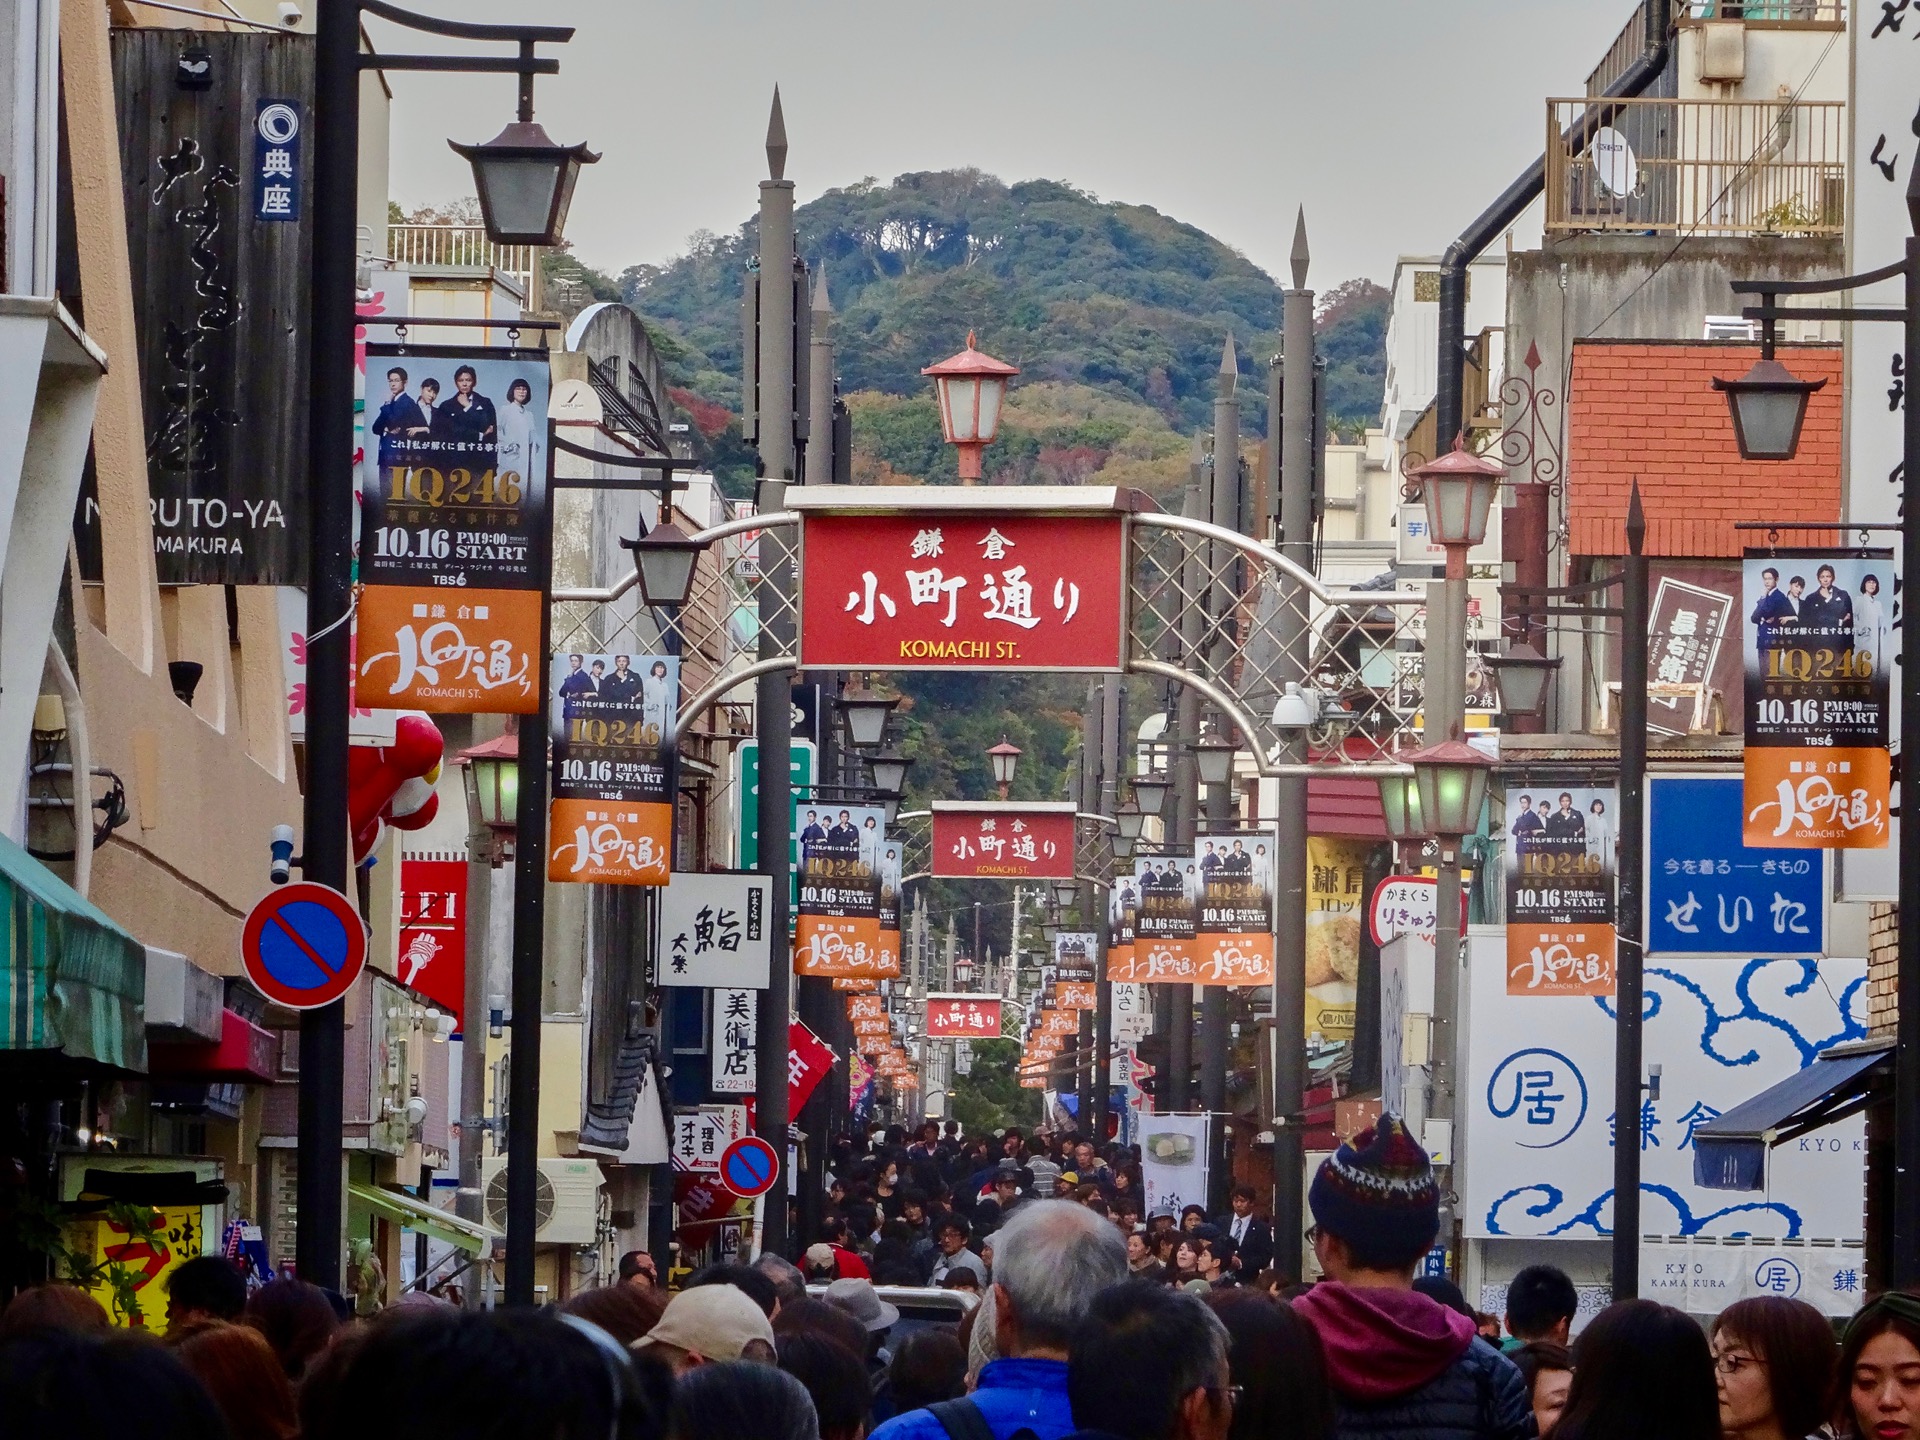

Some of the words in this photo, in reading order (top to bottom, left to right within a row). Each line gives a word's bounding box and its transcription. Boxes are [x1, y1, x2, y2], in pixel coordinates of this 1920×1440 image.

[262, 148, 293, 214] 典座
[386, 466, 521, 508] IQ246
[85, 497, 286, 529] NRUTO-YA
[153, 536, 244, 555] MAKURA
[373, 527, 450, 559] 10.16
[455, 545, 527, 561] START
[910, 527, 1016, 560] 鎌倉
[844, 564, 1080, 629] 小町通り
[430, 604, 471, 620] 鎌倉
[361, 621, 532, 696] 小町通り
[900, 640, 991, 659] KOMACHI
[996, 641, 1021, 660] ST.
[1765, 648, 1873, 682] IQ246
[416, 687, 465, 699] KOMACHI
[467, 688, 482, 699] ST.
[1755, 699, 1818, 725] 10.16
[1823, 712, 1879, 725] START
[570, 718, 661, 748] IQ246
[560, 759, 612, 782] 10.16
[1805, 761, 1837, 774] 鎌倉
[615, 772, 664, 784] START
[1749, 775, 1885, 837] 小町通り
[980, 818, 1027, 833] 鎌倉
[1795, 829, 1835, 839] KOMACHI
[1836, 830, 1846, 839] ST.
[553, 823, 666, 876] 小町通り
[952, 834, 1056, 862] 小町通り
[588, 866, 621, 876] KOMACHI
[976, 865, 1017, 874] KOMACHI
[1018, 866, 1030, 874] ST.
[1523, 851, 1601, 876] IQ246
[800, 886, 837, 903] 10.16
[838, 896, 874, 905] START
[1387, 888, 1429, 902] かまくら
[1515, 888, 1560, 908] 10.16
[1563, 898, 1606, 908] START
[1202, 908, 1235, 922] 10.16
[1311, 898, 1361, 913] コロッ
[1664, 890, 1811, 934] せいた
[1140, 918, 1168, 930] 10.16
[1236, 914, 1267, 922] START
[1383, 907, 1436, 929] りきゅう
[694, 904, 742, 956] 鮨
[1510, 943, 1612, 989] 小町通り
[934, 1012, 995, 1028] 小町通り
[681, 1121, 697, 1158] オオキ
[701, 1127, 715, 1155] 理容
[1799, 1138, 1841, 1152] KYO
[1665, 1264, 1703, 1275] KYO
[1651, 1278, 1726, 1289] KAMAKURA
[1833, 1269, 1859, 1293] 鎌
